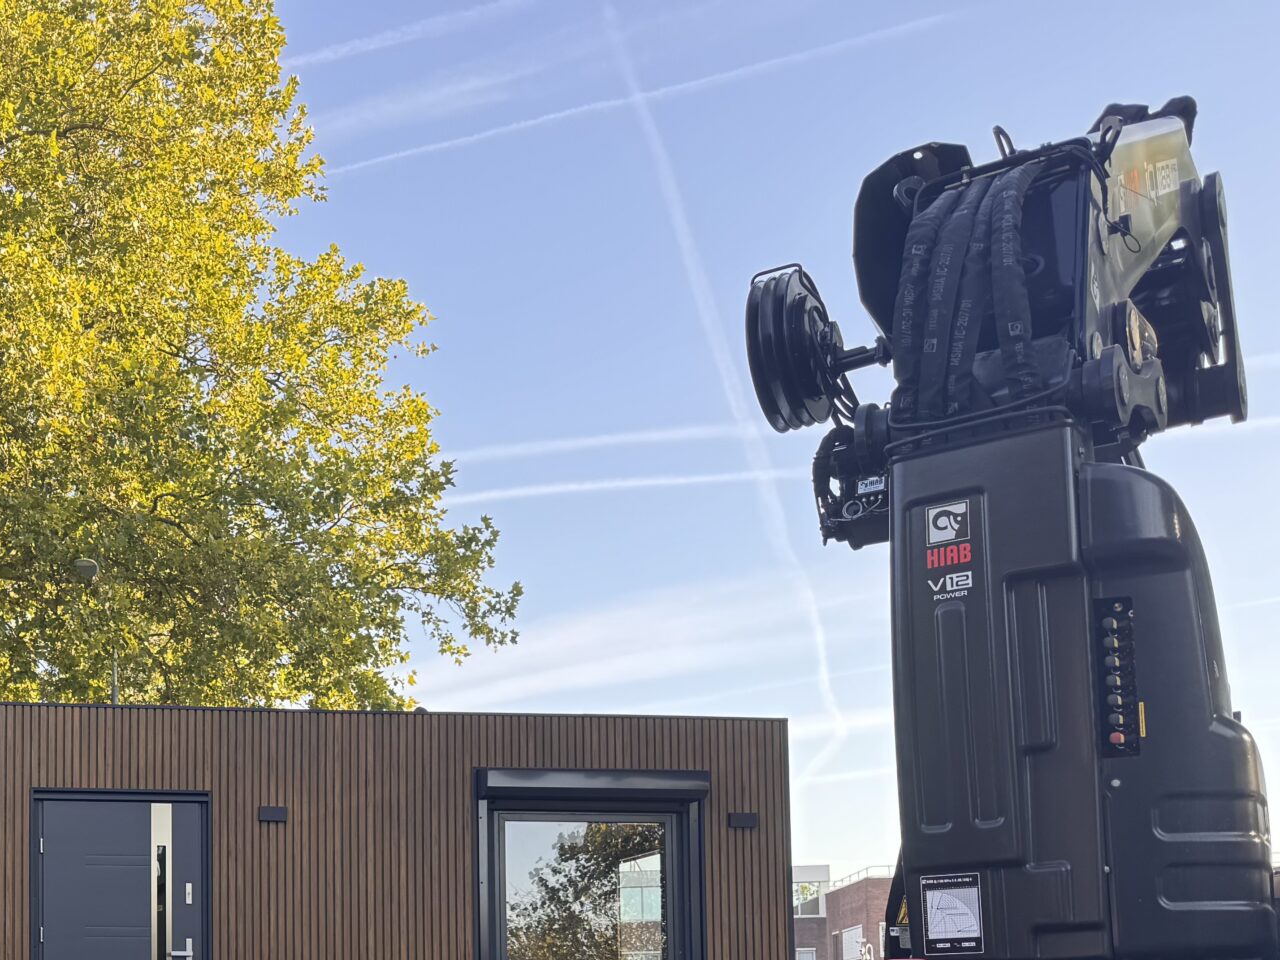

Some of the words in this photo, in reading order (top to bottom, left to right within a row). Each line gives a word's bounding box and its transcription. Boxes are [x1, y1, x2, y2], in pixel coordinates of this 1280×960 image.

[954, 298, 972, 339] IC-207/01
[950, 341, 965, 367] MSHA
[927, 543, 972, 569] HIAB
[927, 571, 972, 592] V12
[933, 590, 968, 601] POWER
